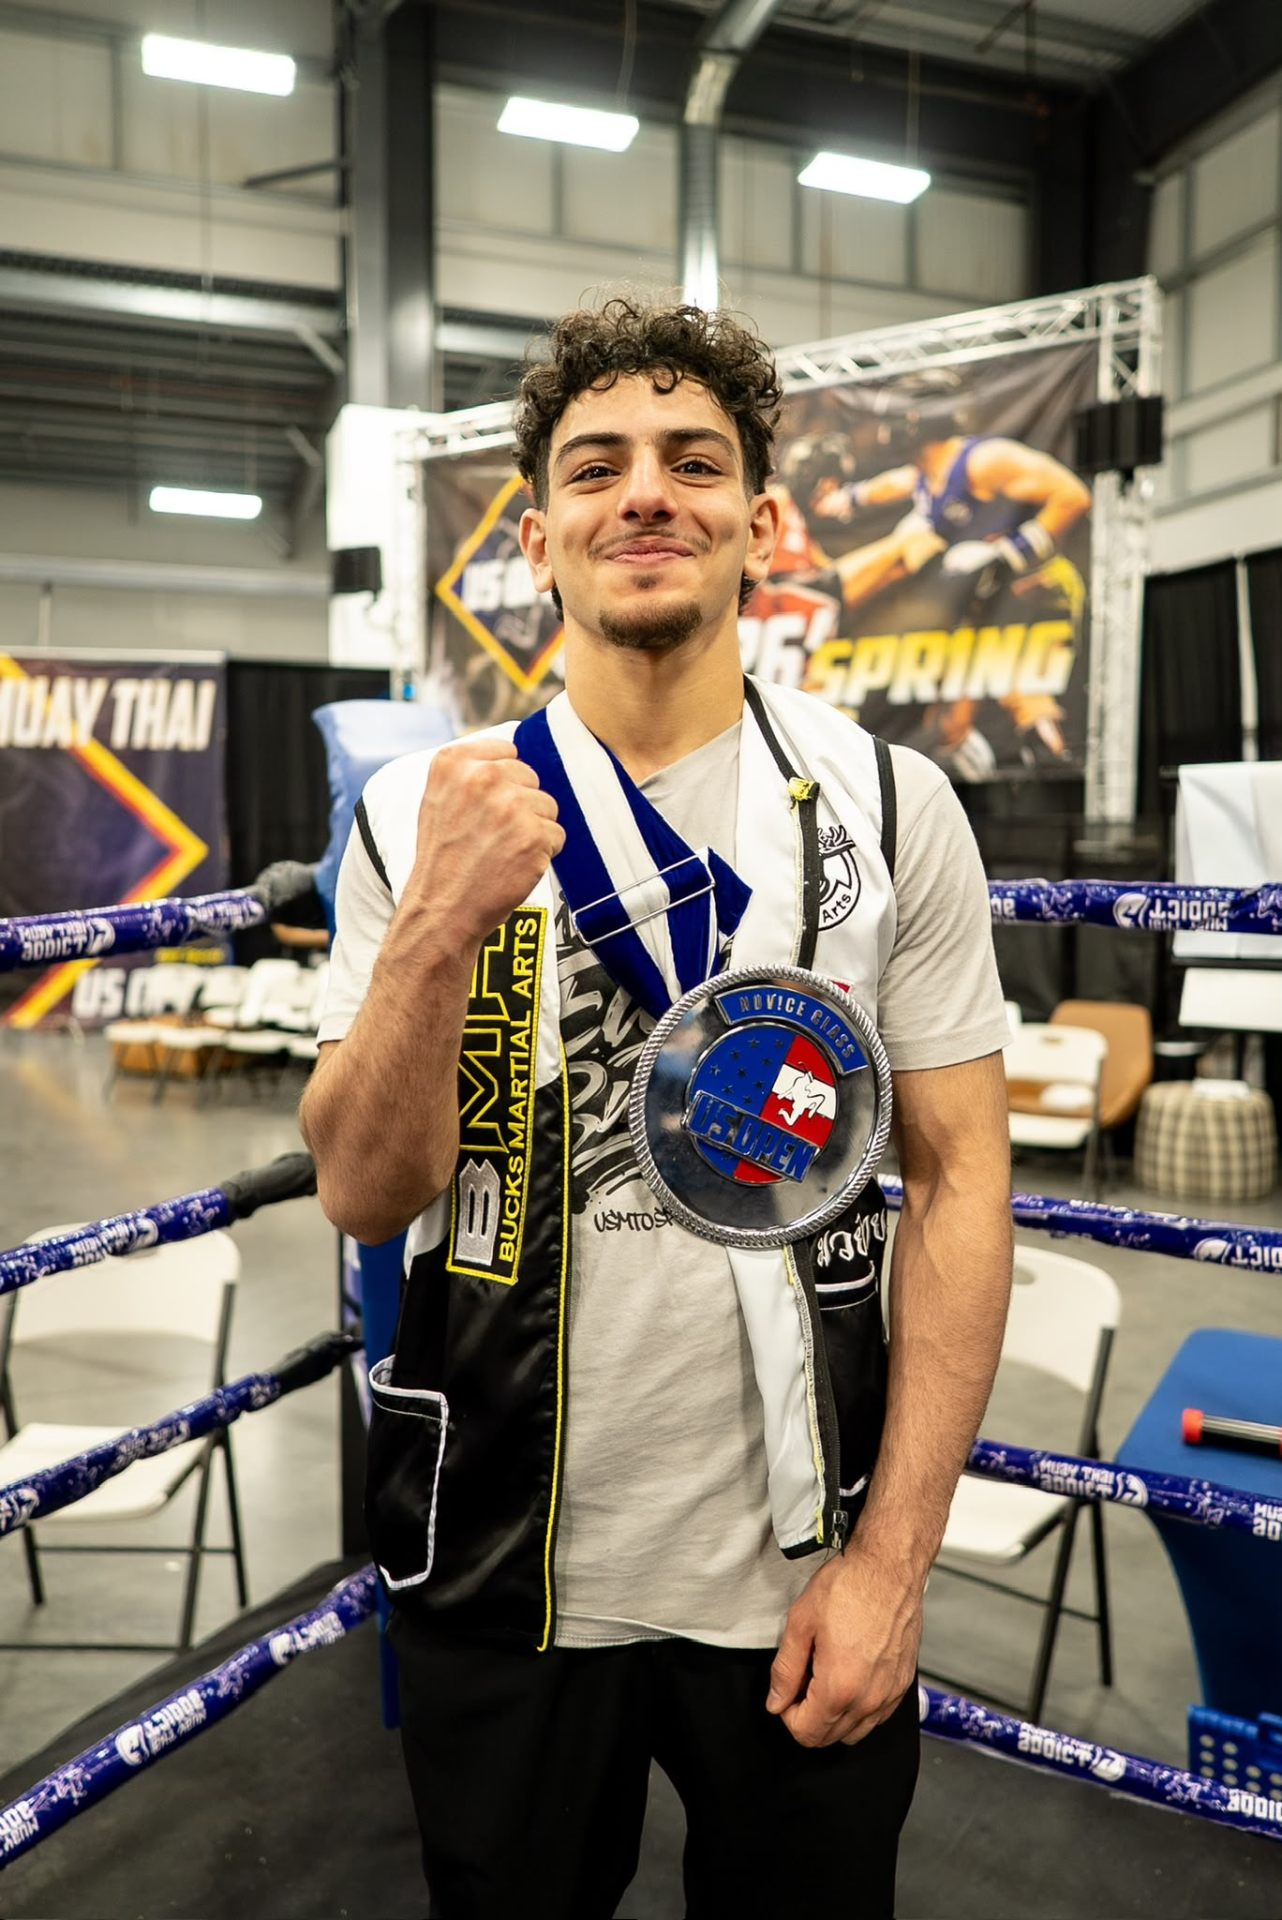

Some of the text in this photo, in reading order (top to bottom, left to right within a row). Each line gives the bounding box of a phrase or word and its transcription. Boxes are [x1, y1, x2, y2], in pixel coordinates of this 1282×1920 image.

[806, 618, 1076, 706] SPRING
[109, 677, 216, 750] THAI
[821, 893, 852, 923] Arts
[72, 967, 127, 1019] US
[739, 994, 856, 1060] NOVICE CLASS
[499, 917, 538, 1263] BUCKS MARTIAL ARTS
[693, 1093, 816, 1181] US OPEN
